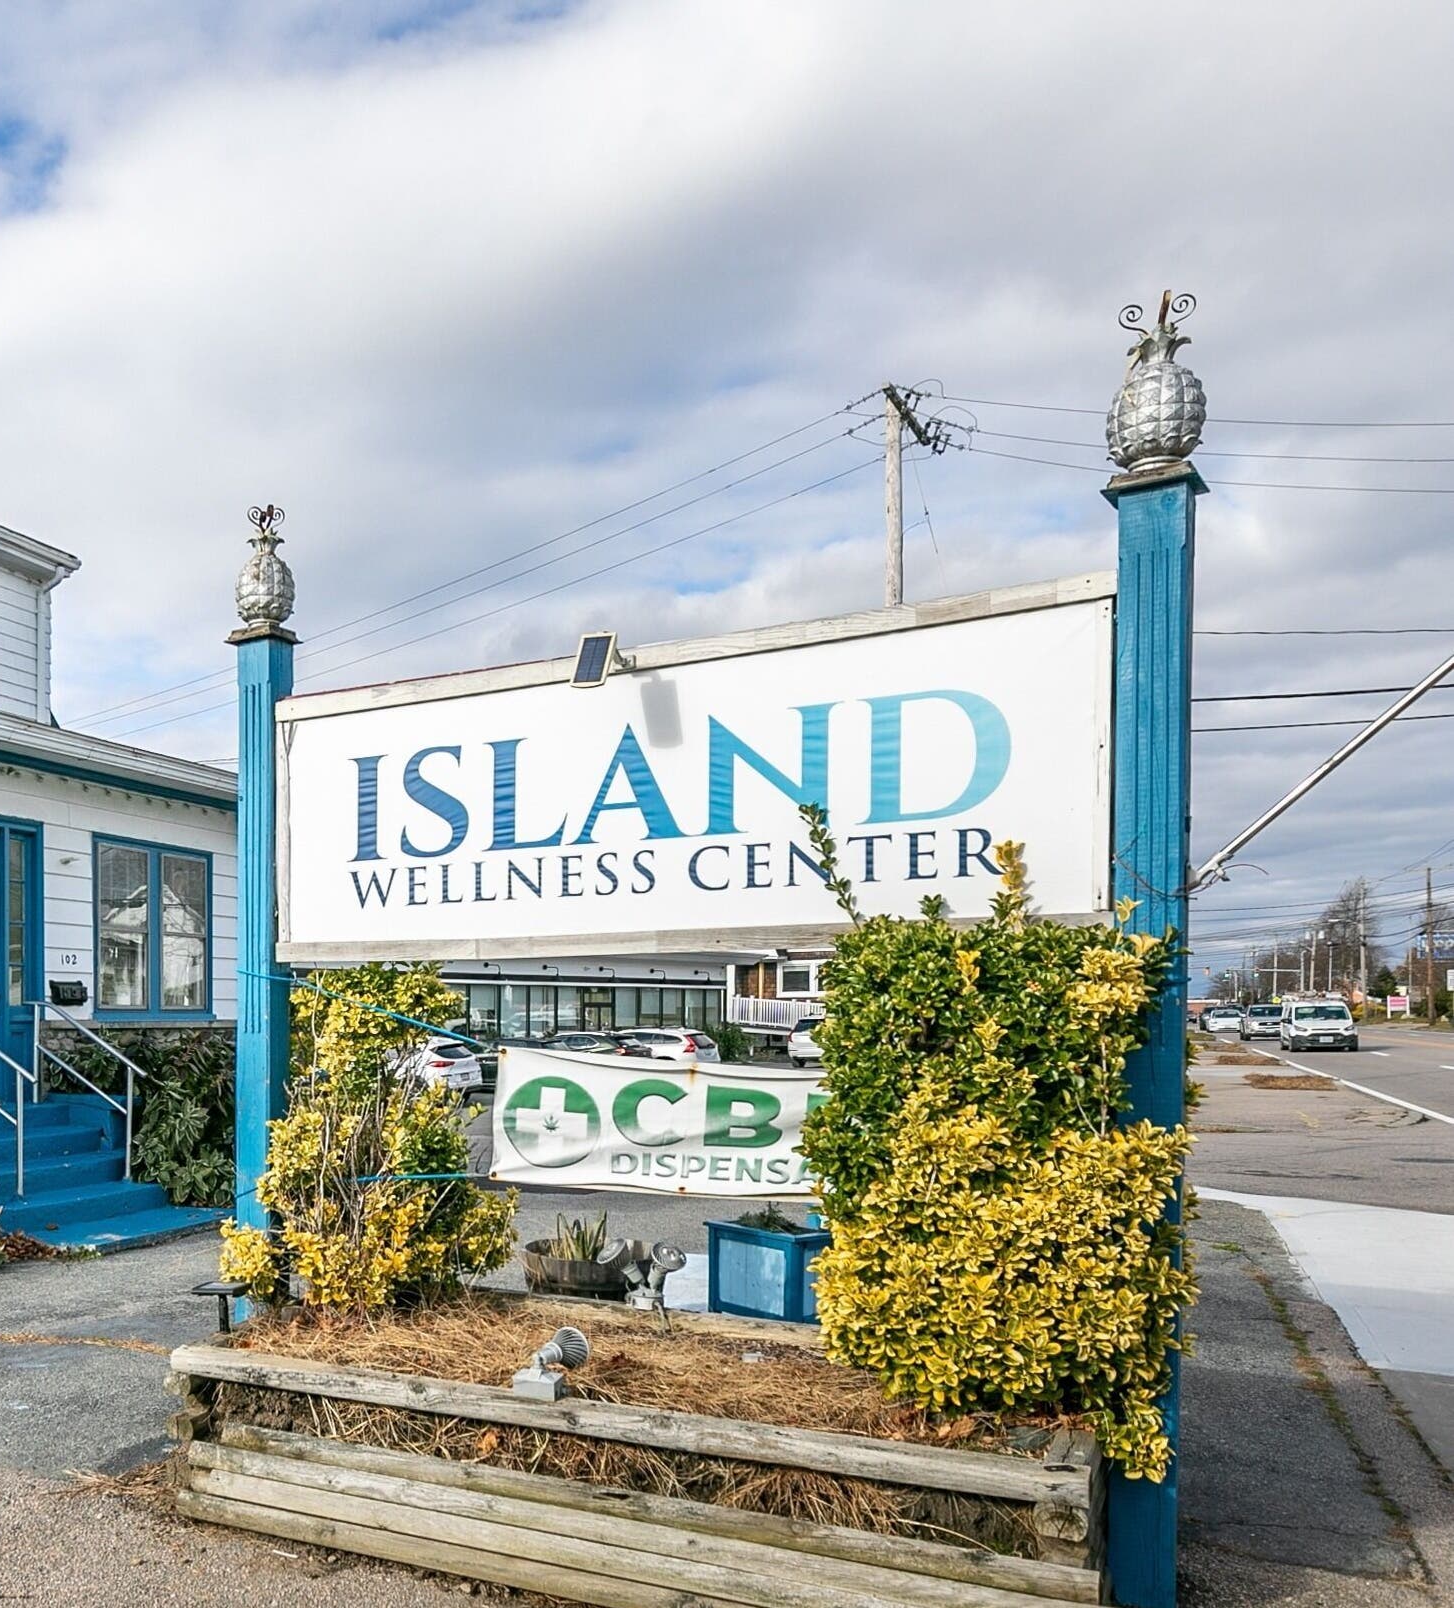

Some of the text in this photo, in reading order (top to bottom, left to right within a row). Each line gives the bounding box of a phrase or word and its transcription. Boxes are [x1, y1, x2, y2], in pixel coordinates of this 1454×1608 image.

[349, 689, 1012, 863] ISLAND
[350, 828, 1005, 909] WELLNESS CENTER
[61, 954, 78, 965] 102
[612, 1078, 830, 1148] CB
